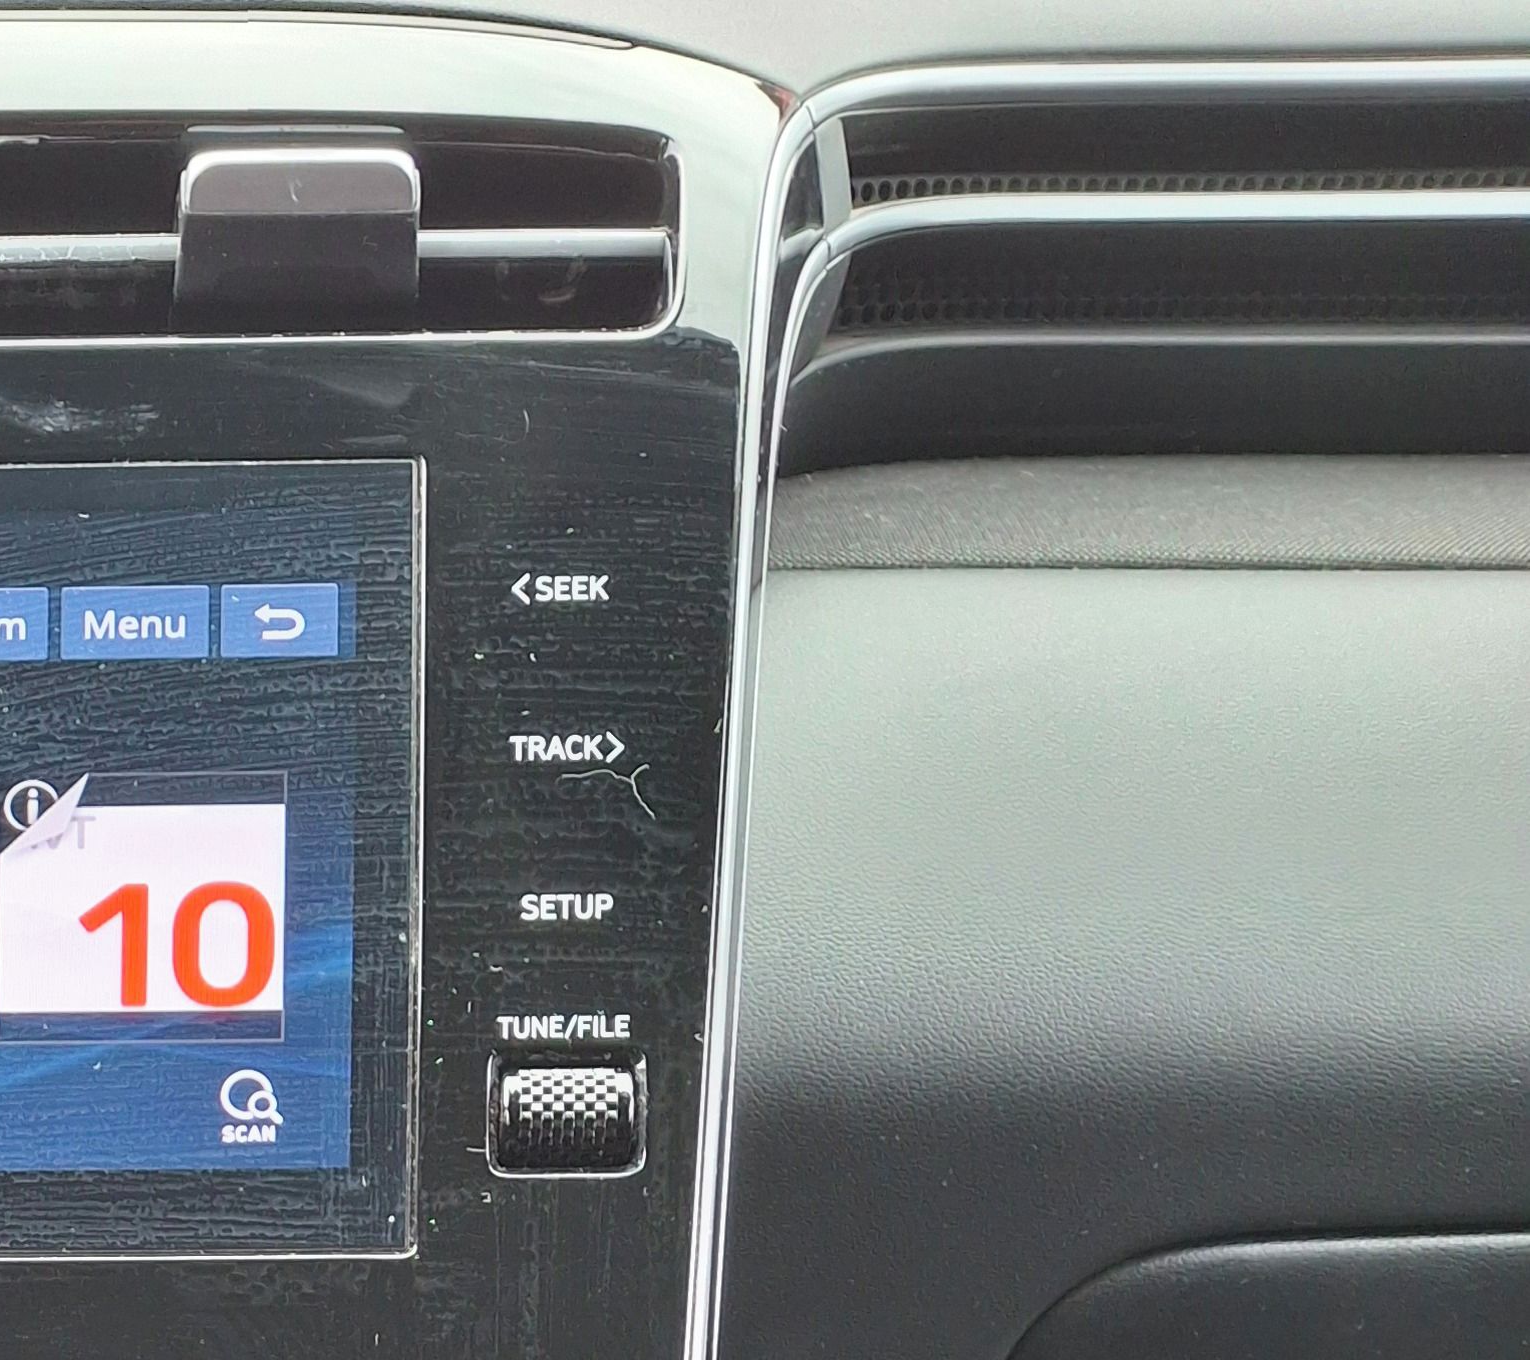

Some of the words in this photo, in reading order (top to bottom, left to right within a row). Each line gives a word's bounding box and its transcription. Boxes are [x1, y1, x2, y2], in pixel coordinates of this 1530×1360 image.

[535, 575, 609, 601] SEEK
[83, 609, 187, 640] Menu
[510, 735, 603, 761] TRACK
[520, 894, 614, 921] SETUP
[79, 881, 276, 1007] 10
[497, 1015, 631, 1040] TUNE/FILE
[221, 1125, 277, 1143] SCAN
